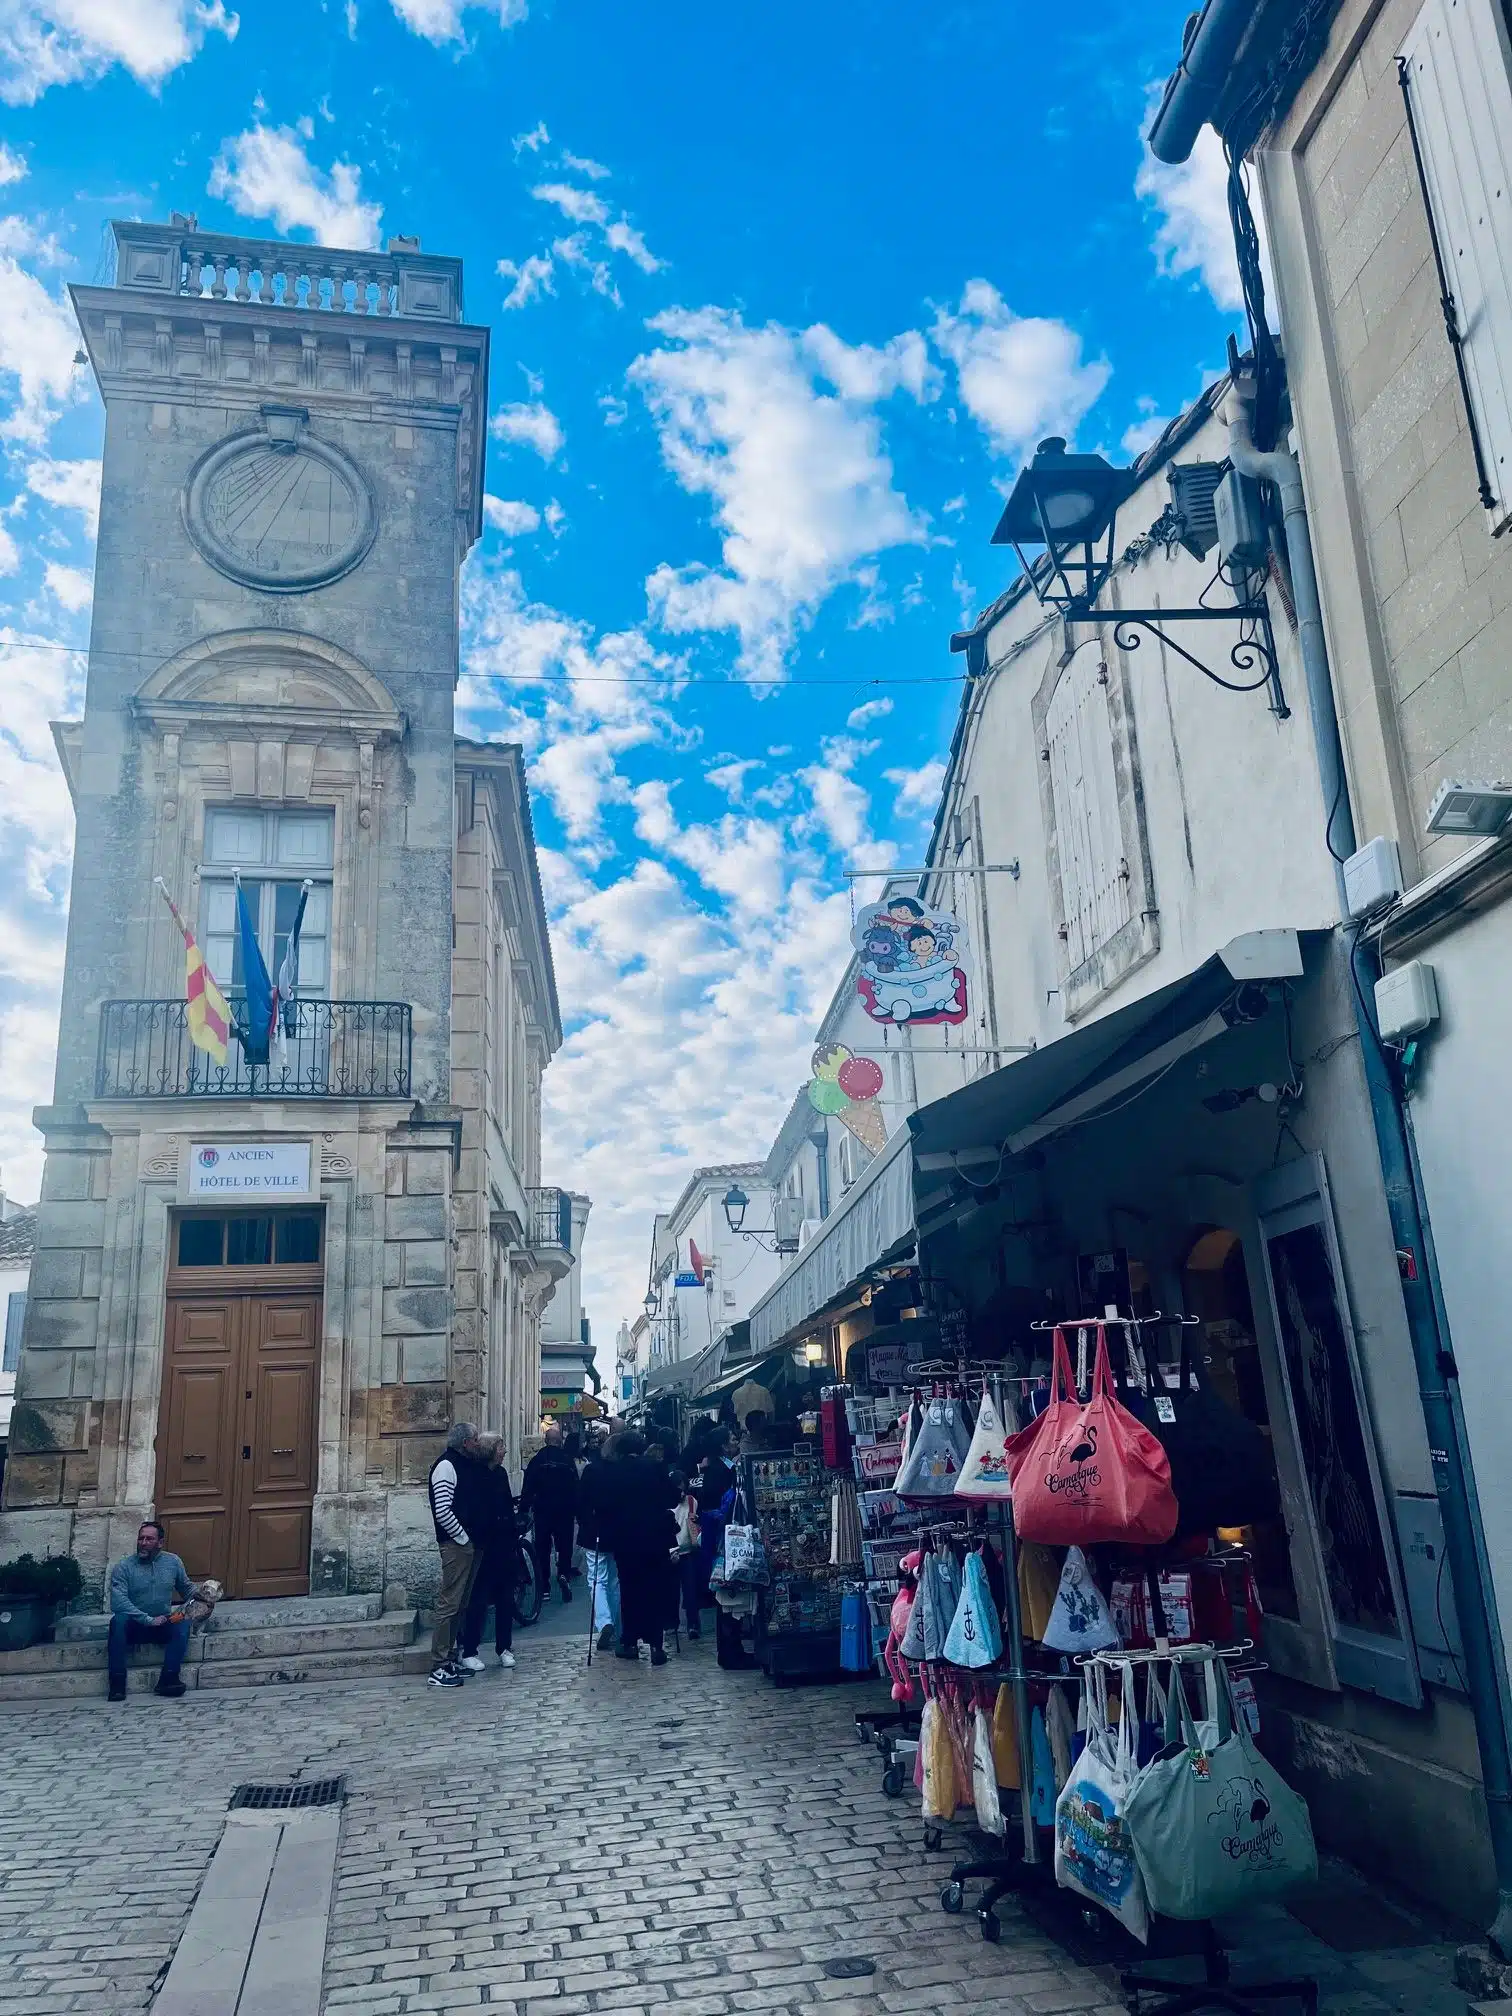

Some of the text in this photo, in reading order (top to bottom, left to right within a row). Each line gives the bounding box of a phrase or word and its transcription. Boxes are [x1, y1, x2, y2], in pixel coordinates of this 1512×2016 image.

[316, 543, 332, 555] XII
[246, 550, 260, 562] XI
[227, 1150, 275, 1161] ANCIEN
[200, 1175, 299, 1187] HÔTEL DE VILLE
[1044, 1465, 1102, 1498] Camargue
